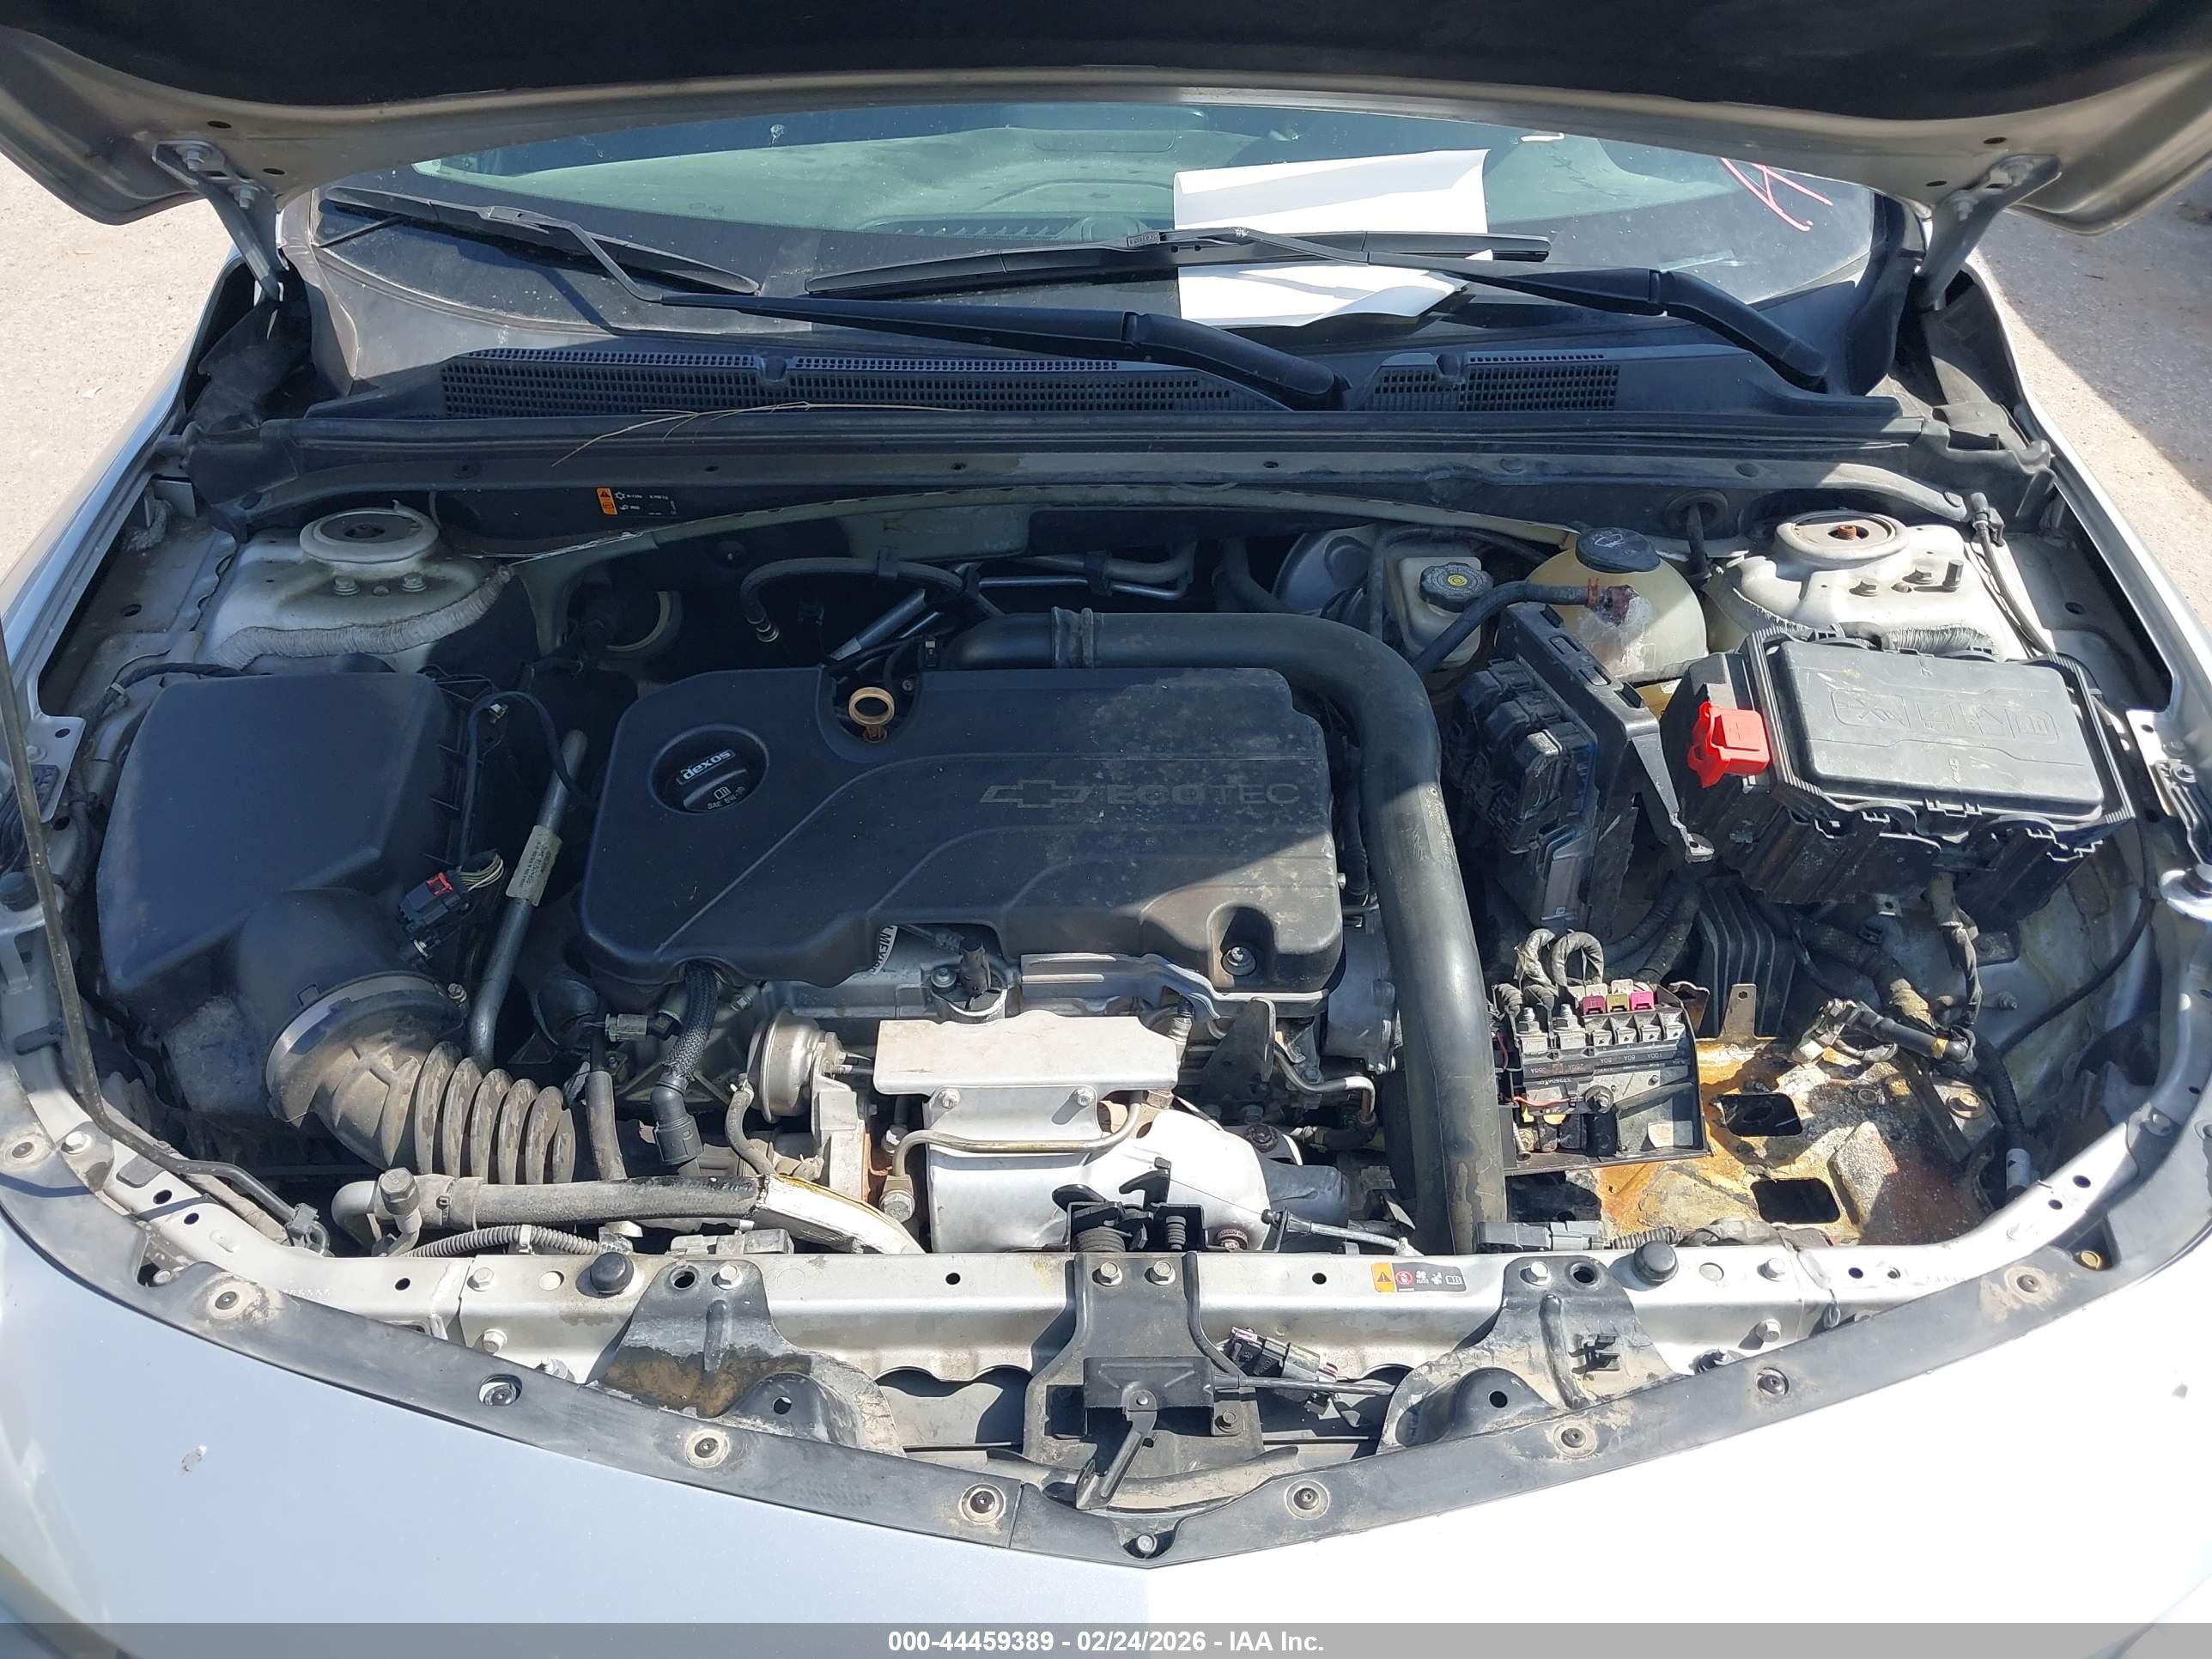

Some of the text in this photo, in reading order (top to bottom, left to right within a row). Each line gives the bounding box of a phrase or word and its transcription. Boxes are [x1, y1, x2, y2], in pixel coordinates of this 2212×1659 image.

[683, 751, 732, 780] dexos
[707, 800, 723, 810] SAE
[1107, 783, 1301, 805] ECOTEC
